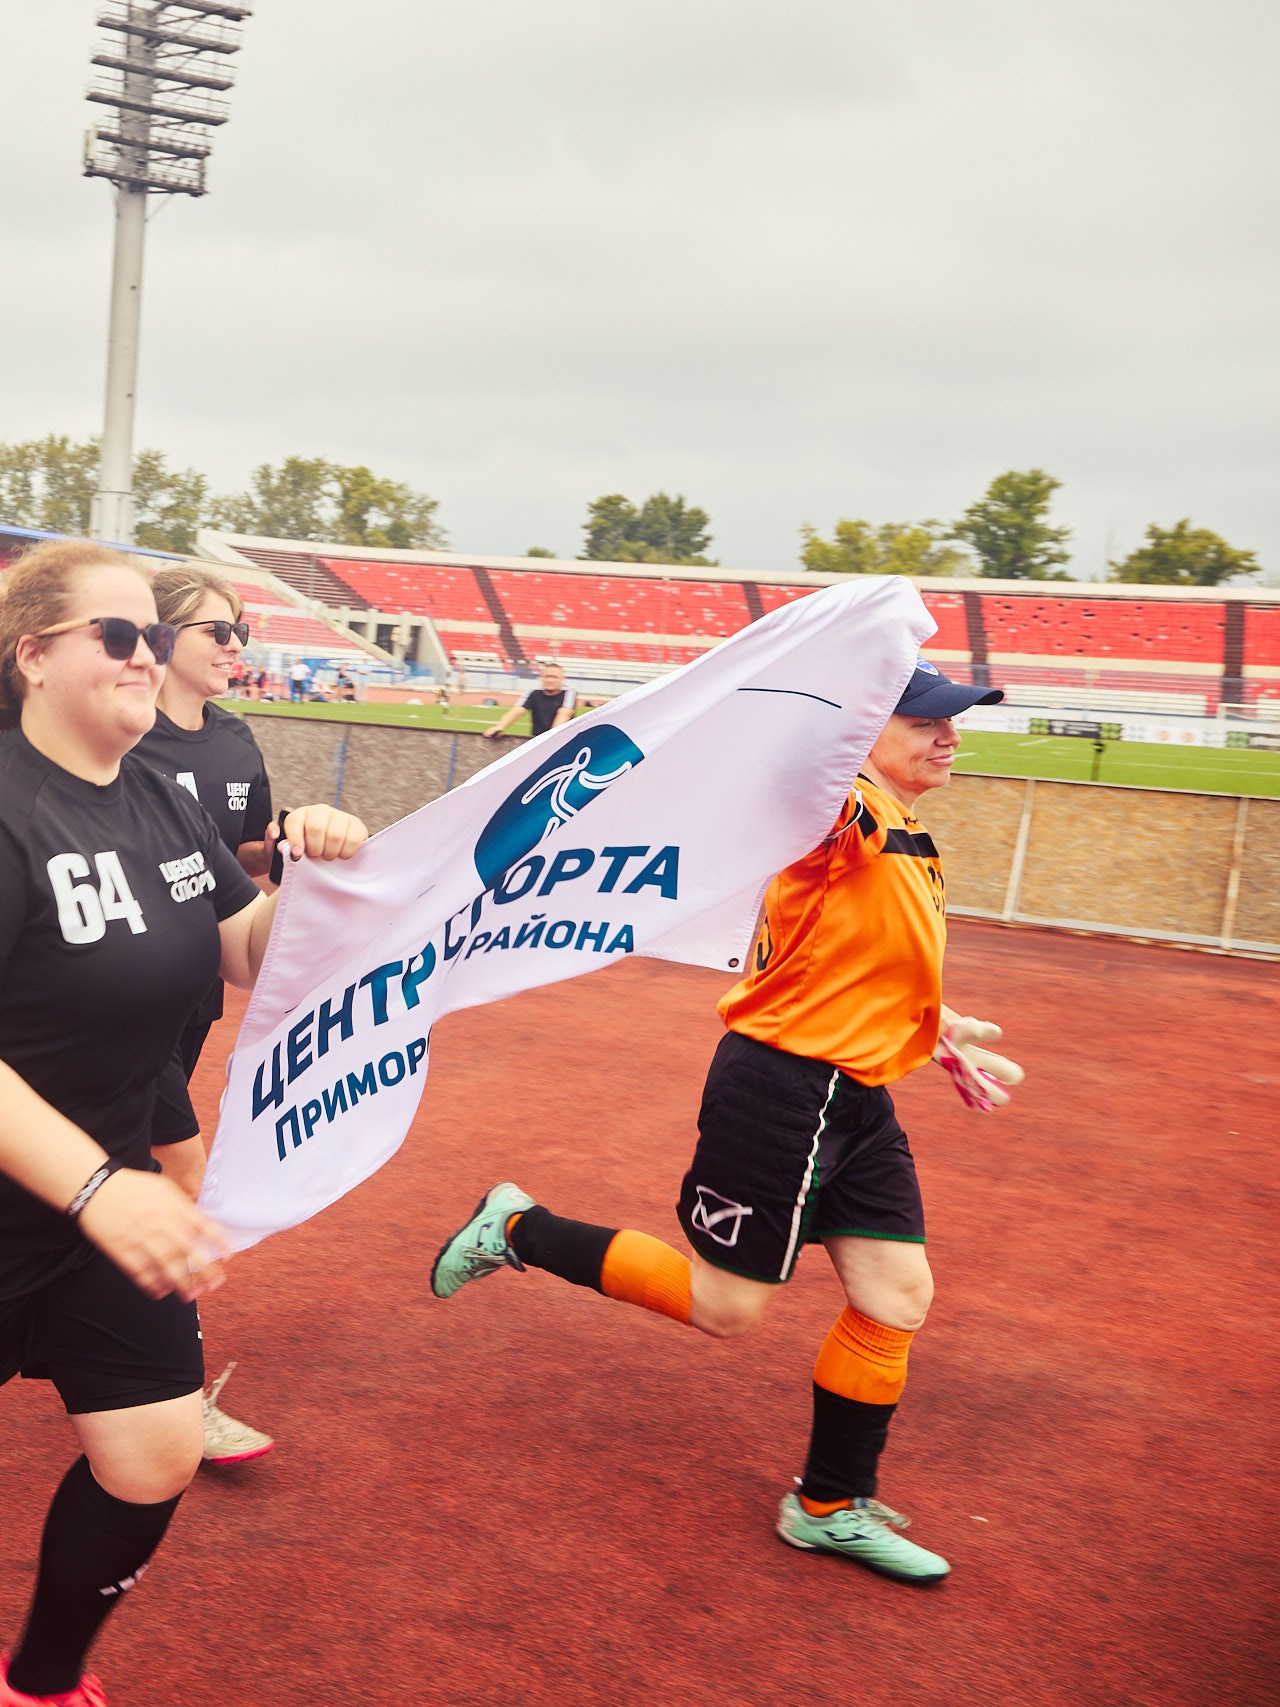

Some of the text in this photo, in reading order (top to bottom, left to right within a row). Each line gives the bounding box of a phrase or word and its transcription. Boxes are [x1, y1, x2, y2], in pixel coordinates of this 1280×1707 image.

[226, 783, 251, 796] ЦЕНТ
[47, 851, 147, 944] 64
[252, 941, 437, 1122] ЦЕНТР
[275, 914, 634, 1162] ПРИМОР РАЙОНА
